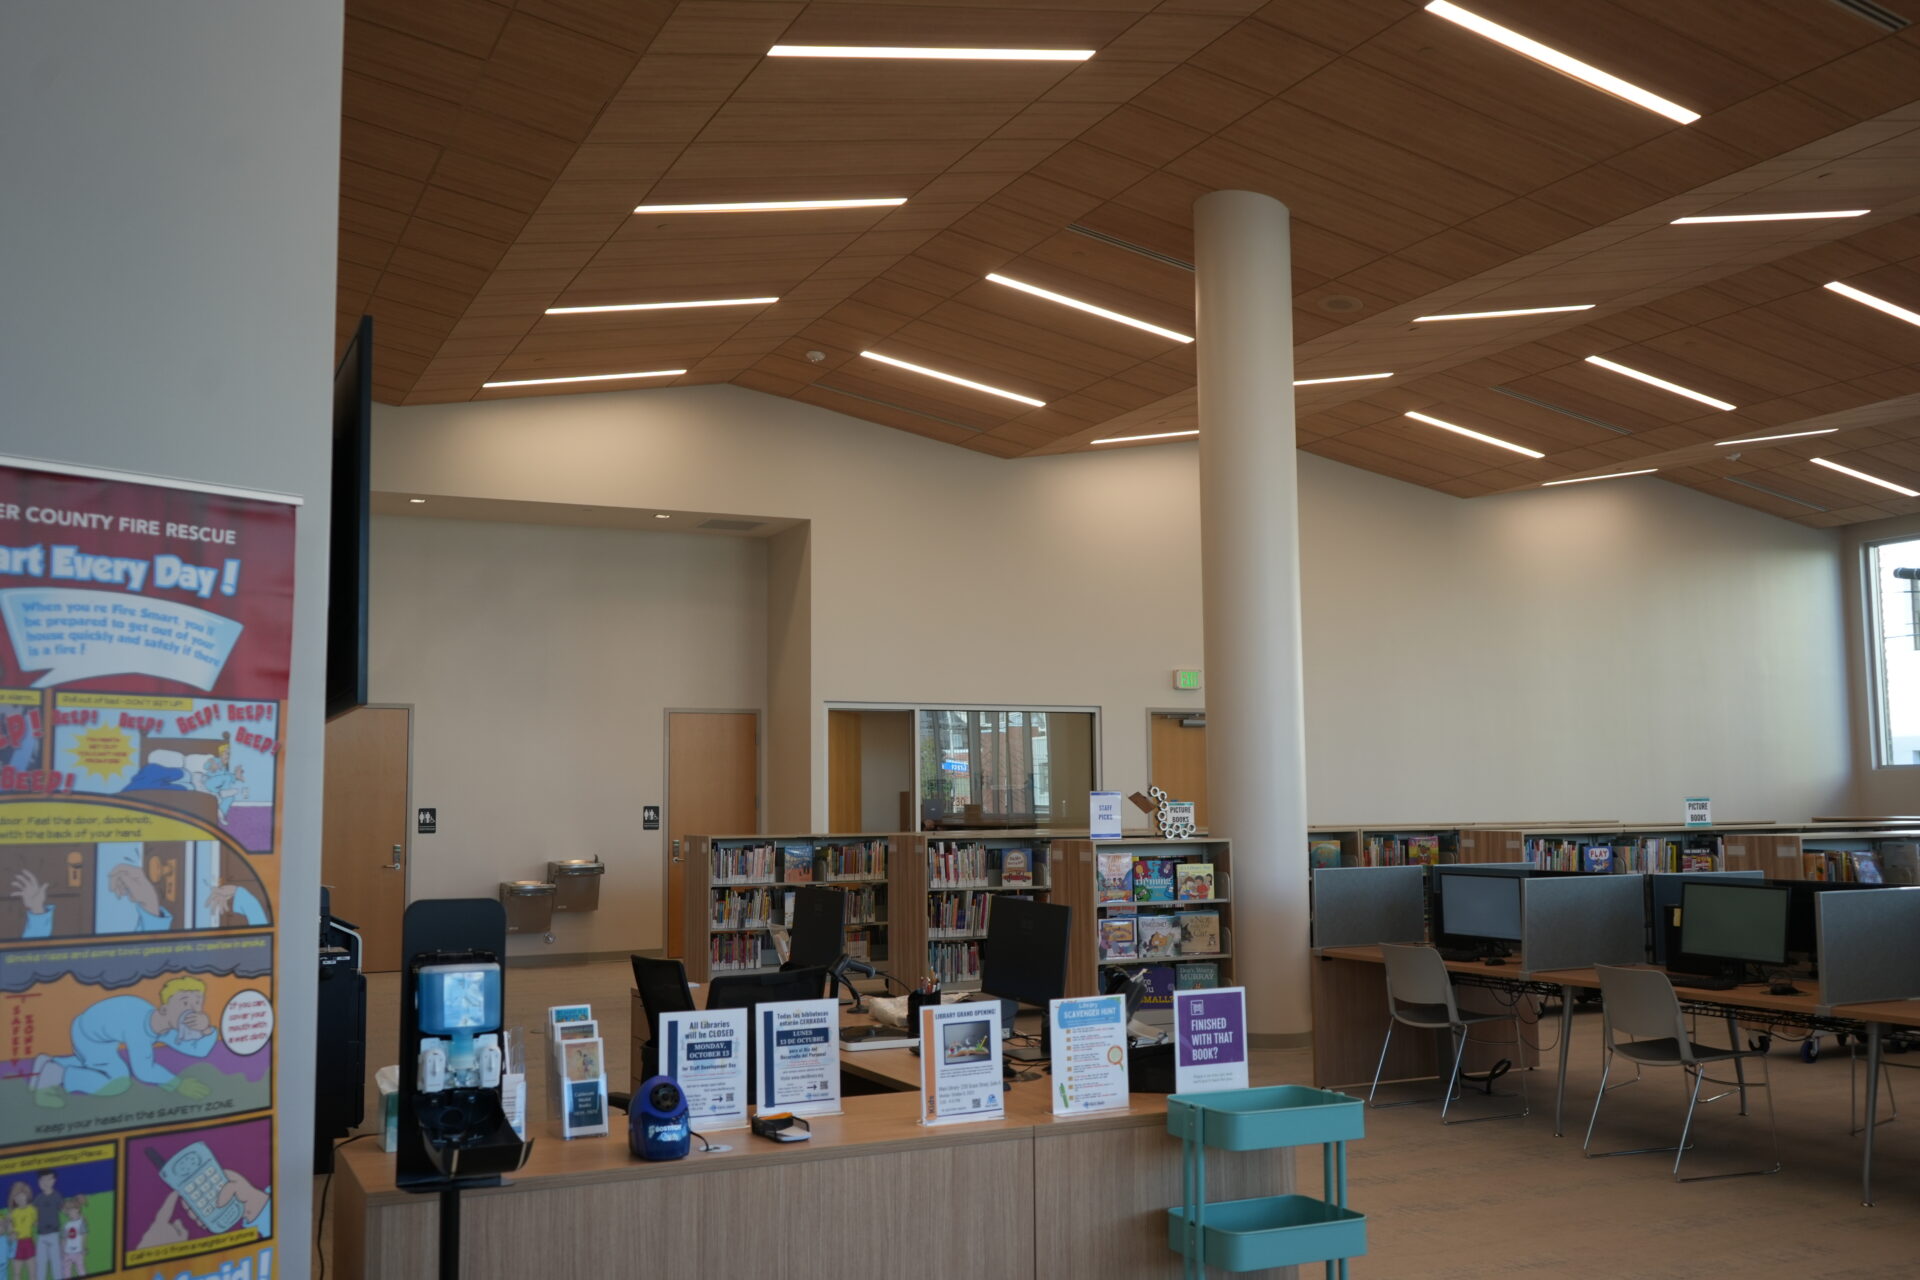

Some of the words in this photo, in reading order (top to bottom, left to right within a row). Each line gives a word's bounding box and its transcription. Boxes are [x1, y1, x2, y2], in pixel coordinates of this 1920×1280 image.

[25, 506, 114, 530] COUNTY
[118, 517, 160, 536] FIRE
[166, 522, 236, 545] RESCUE
[50, 544, 150, 592] Every
[154, 554, 218, 598] Day
[22, 602, 62, 612] When
[112, 604, 136, 616] Fire
[24, 616, 41, 628] be
[45, 617, 108, 629] prepared
[112, 618, 125, 630] to
[128, 621, 148, 633] get
[152, 626, 173, 637] out
[176, 631, 189, 640] of
[192, 637, 215, 650] your
[26, 631, 64, 642] house
[68, 630, 114, 644] quickly
[117, 634, 141, 646] and
[144, 639, 180, 655] safely
[182, 644, 192, 656] if
[194, 650, 221, 668] there
[28, 646, 39, 656] is
[54, 644, 77, 656] fire
[51, 710, 98, 726] BEEP!
[176, 704, 220, 735] BEEP!
[227, 704, 272, 722] BEEP!
[118, 712, 164, 734] BEEP!
[235, 726, 282, 756] BEEP!
[1, 766, 76, 794] BEEP!
[1170, 806, 1191, 814] PICTURE
[1688, 802, 1708, 810] PICTURE
[1690, 814, 1706, 822] BOOKS
[1590, 850, 1608, 858] PLAY
[1141, 995, 1174, 1003] MALL?
[936, 1012, 955, 1020] LIBRARY
[1064, 1009, 1099, 1019] SCAVENGER
[1100, 1008, 1116, 1016] HUNT
[700, 1020, 730, 1029] Libraries
[800, 1017, 827, 1025] CERRADAS
[1191, 1018, 1227, 1031] FINISHED
[708, 1030, 734, 1038] CLOSED
[797, 1036, 824, 1044] OCTUBRE
[1192, 1033, 1212, 1046] WITH
[1214, 1032, 1233, 1044] THAT
[689, 1051, 721, 1059] OCTOBER
[1192, 1047, 1218, 1061] BOOK?
[34, 1123, 64, 1134] Keep
[67, 1119, 92, 1131] your
[94, 1114, 121, 1126] head
[136, 1110, 155, 1120] the
[157, 1104, 203, 1118] SAFETY
